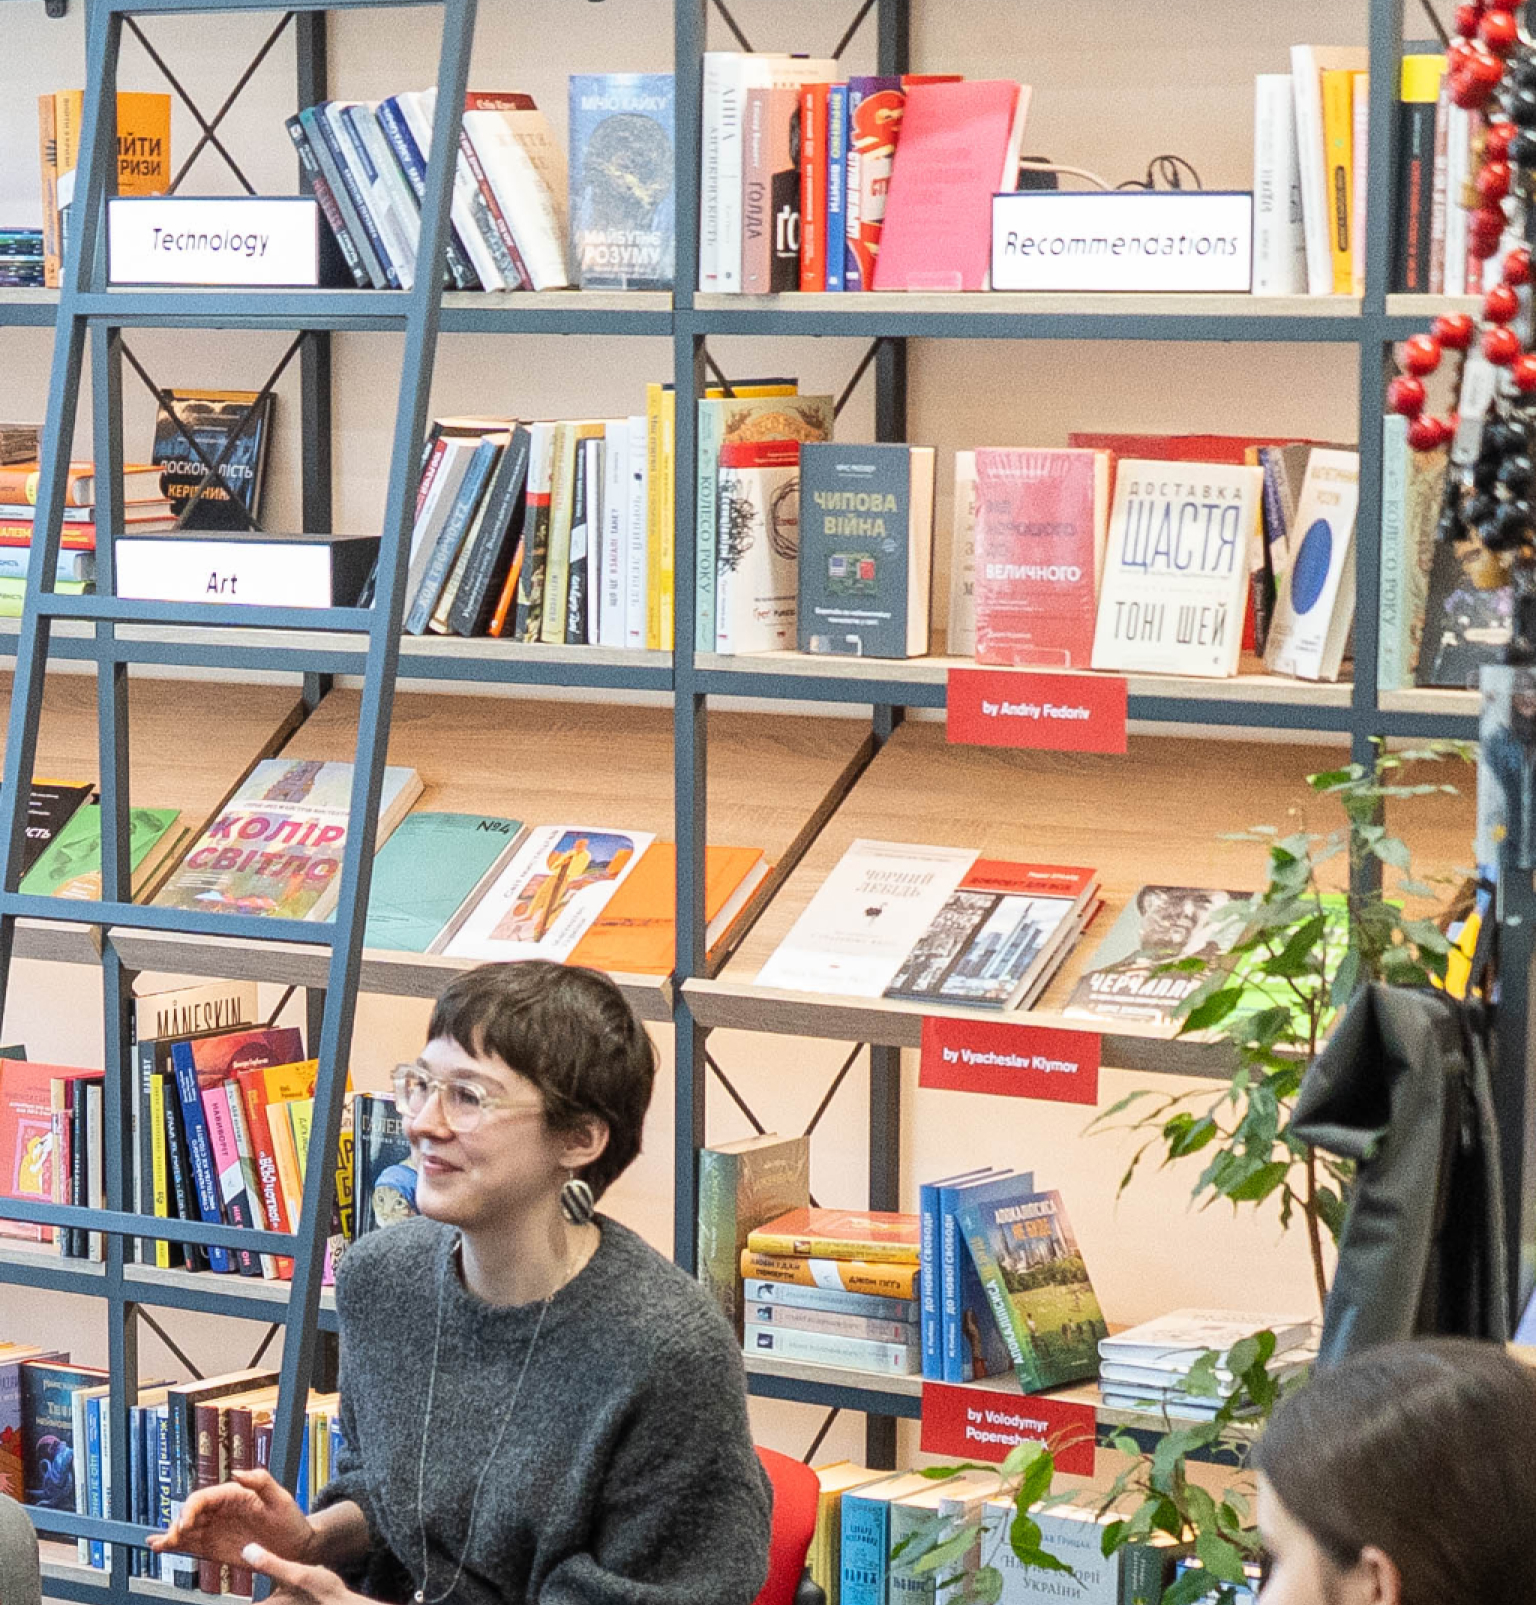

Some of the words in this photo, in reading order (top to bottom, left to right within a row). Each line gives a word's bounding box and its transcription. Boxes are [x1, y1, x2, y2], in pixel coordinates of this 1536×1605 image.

[830, 164, 841, 213] ВІРИТИ
[747, 180, 766, 240] ҐОЛДА
[153, 228, 269, 257] Technology
[584, 245, 661, 265] РОЗУМУ
[1004, 231, 1239, 256] Recommendations
[160, 460, 254, 480] ДОСКОНЛІСТЬ
[814, 491, 897, 513] ЧИПОВА
[1129, 481, 1243, 500] ДОСТАВКА
[699, 475, 711, 543] КОЛЕСО
[824, 513, 886, 537] ВІЙНА
[431, 502, 469, 580] ТВОРЧОСТІ
[1121, 499, 1240, 574] ЩАСТЯ
[1385, 501, 1398, 568] КОЛЕСО
[206, 571, 238, 595] Art
[698, 547, 711, 594] РОКУ
[986, 564, 1081, 582] ВЕЛИЧНОГО
[1382, 575, 1397, 628] РОКУ
[1114, 600, 1166, 642] ТОНІ
[1176, 601, 1227, 647] ШЕЙ
[981, 700, 999, 716] by
[1000, 702, 1041, 719] Andriy
[1043, 703, 1090, 720] Fedoriv
[208, 815, 347, 848] КОЛІР
[187, 847, 340, 881] СВІТЛО
[863, 868, 935, 886] ЧОРНИЙ
[855, 881, 922, 898] ЛЕБІДЬ
[156, 996, 242, 1039] MÅNESKIN
[942, 1047, 958, 1066] by
[961, 1049, 1029, 1071] Vyacheslav
[1032, 1056, 1079, 1074] Klymov
[212, 1102, 228, 1157] НАВИВОРІТ
[923, 1212, 933, 1260] СВОБОДИ
[944, 1214, 954, 1262] СВОБОДИ
[925, 1262, 934, 1295] НОВОЇ
[946, 1264, 955, 1297] НОВОЇ
[986, 1279, 1024, 1365] АПОКАЛІПСИСА
[967, 1408, 983, 1423] by
[985, 1409, 1049, 1432] Volodymyr
[1022, 1577, 1082, 1599] УКРАЇНИ
